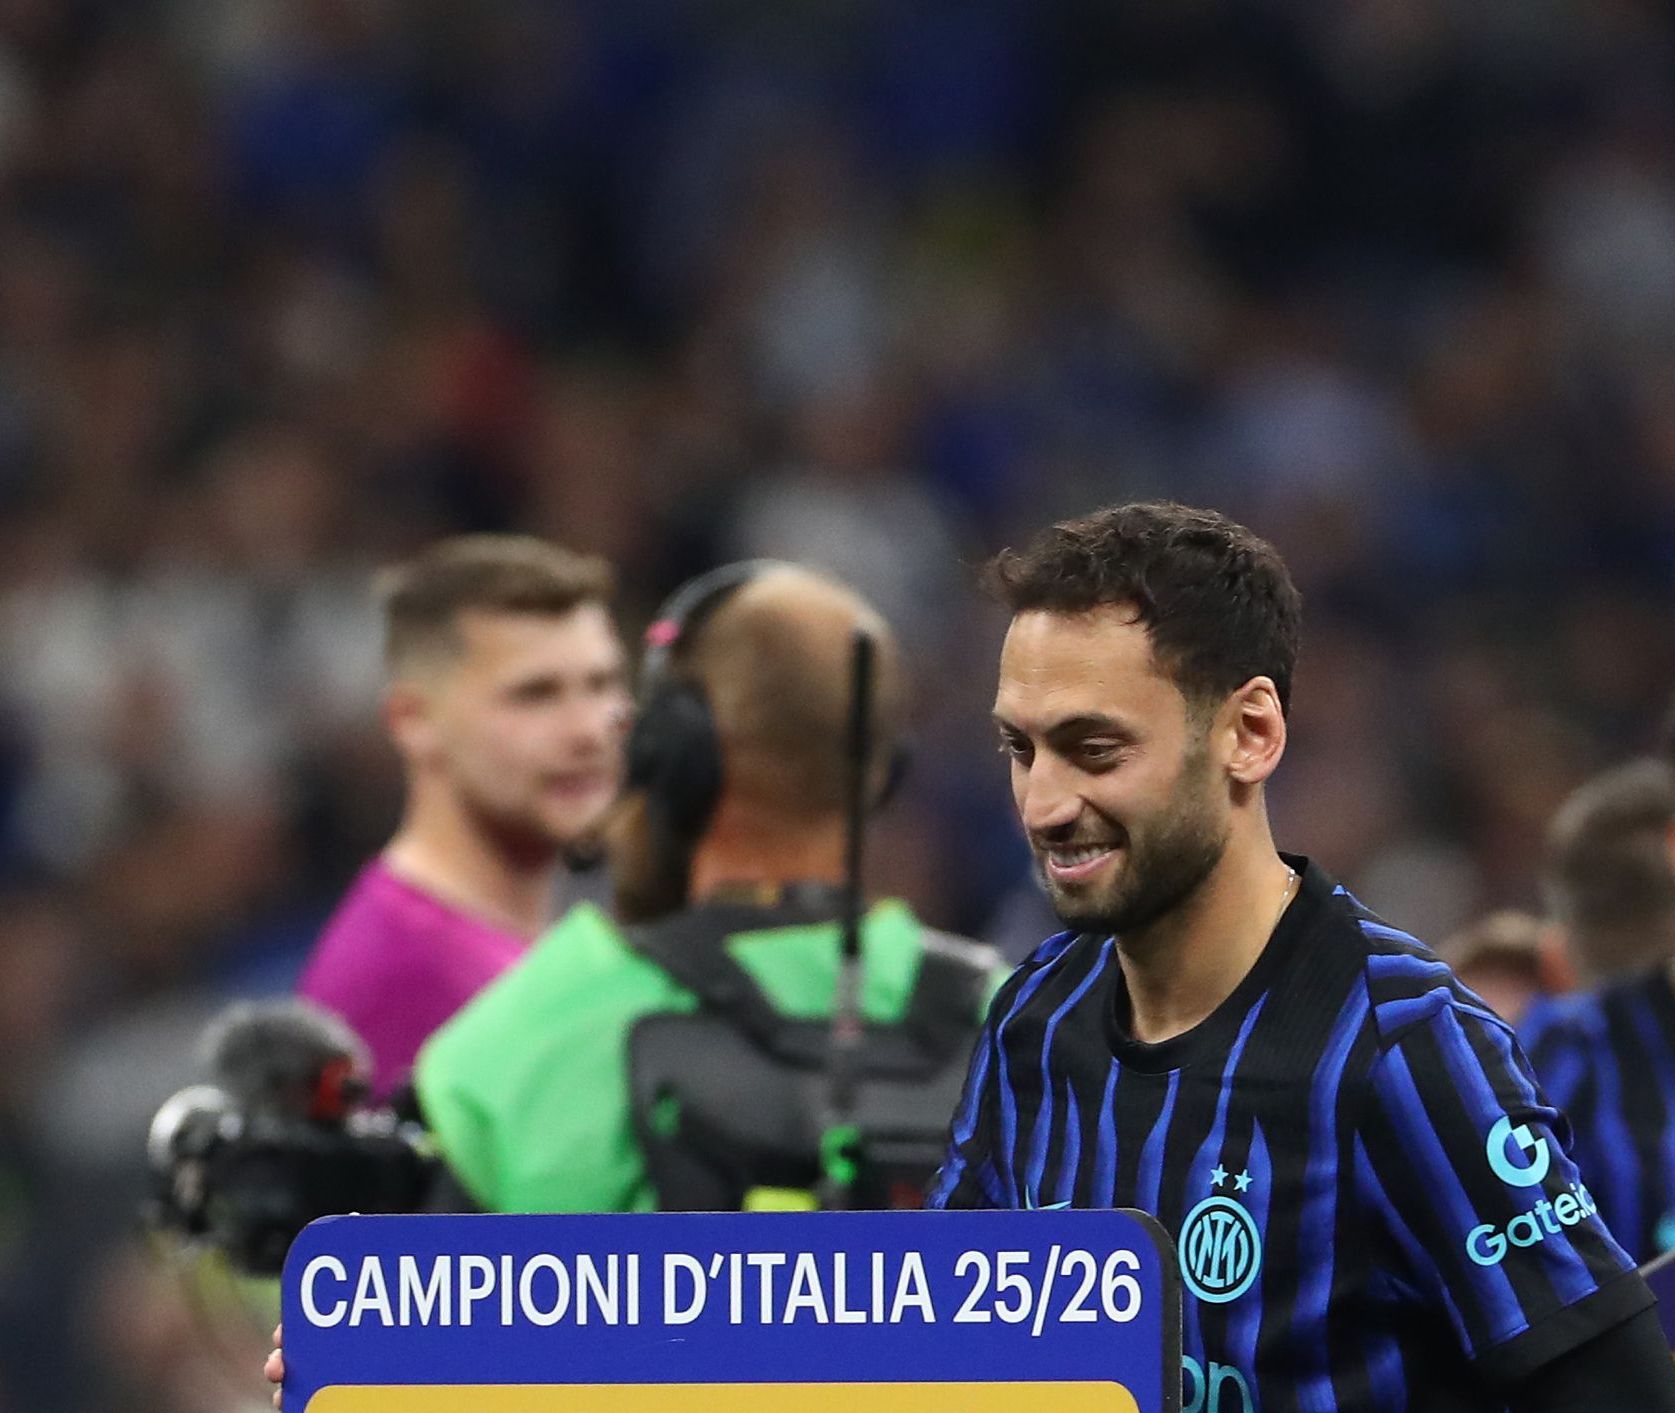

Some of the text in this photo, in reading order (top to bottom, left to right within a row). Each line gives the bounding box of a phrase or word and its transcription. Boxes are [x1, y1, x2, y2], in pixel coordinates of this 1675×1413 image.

[300, 1244, 1142, 1337] CAMPIONI D’ITALIA 25/26
